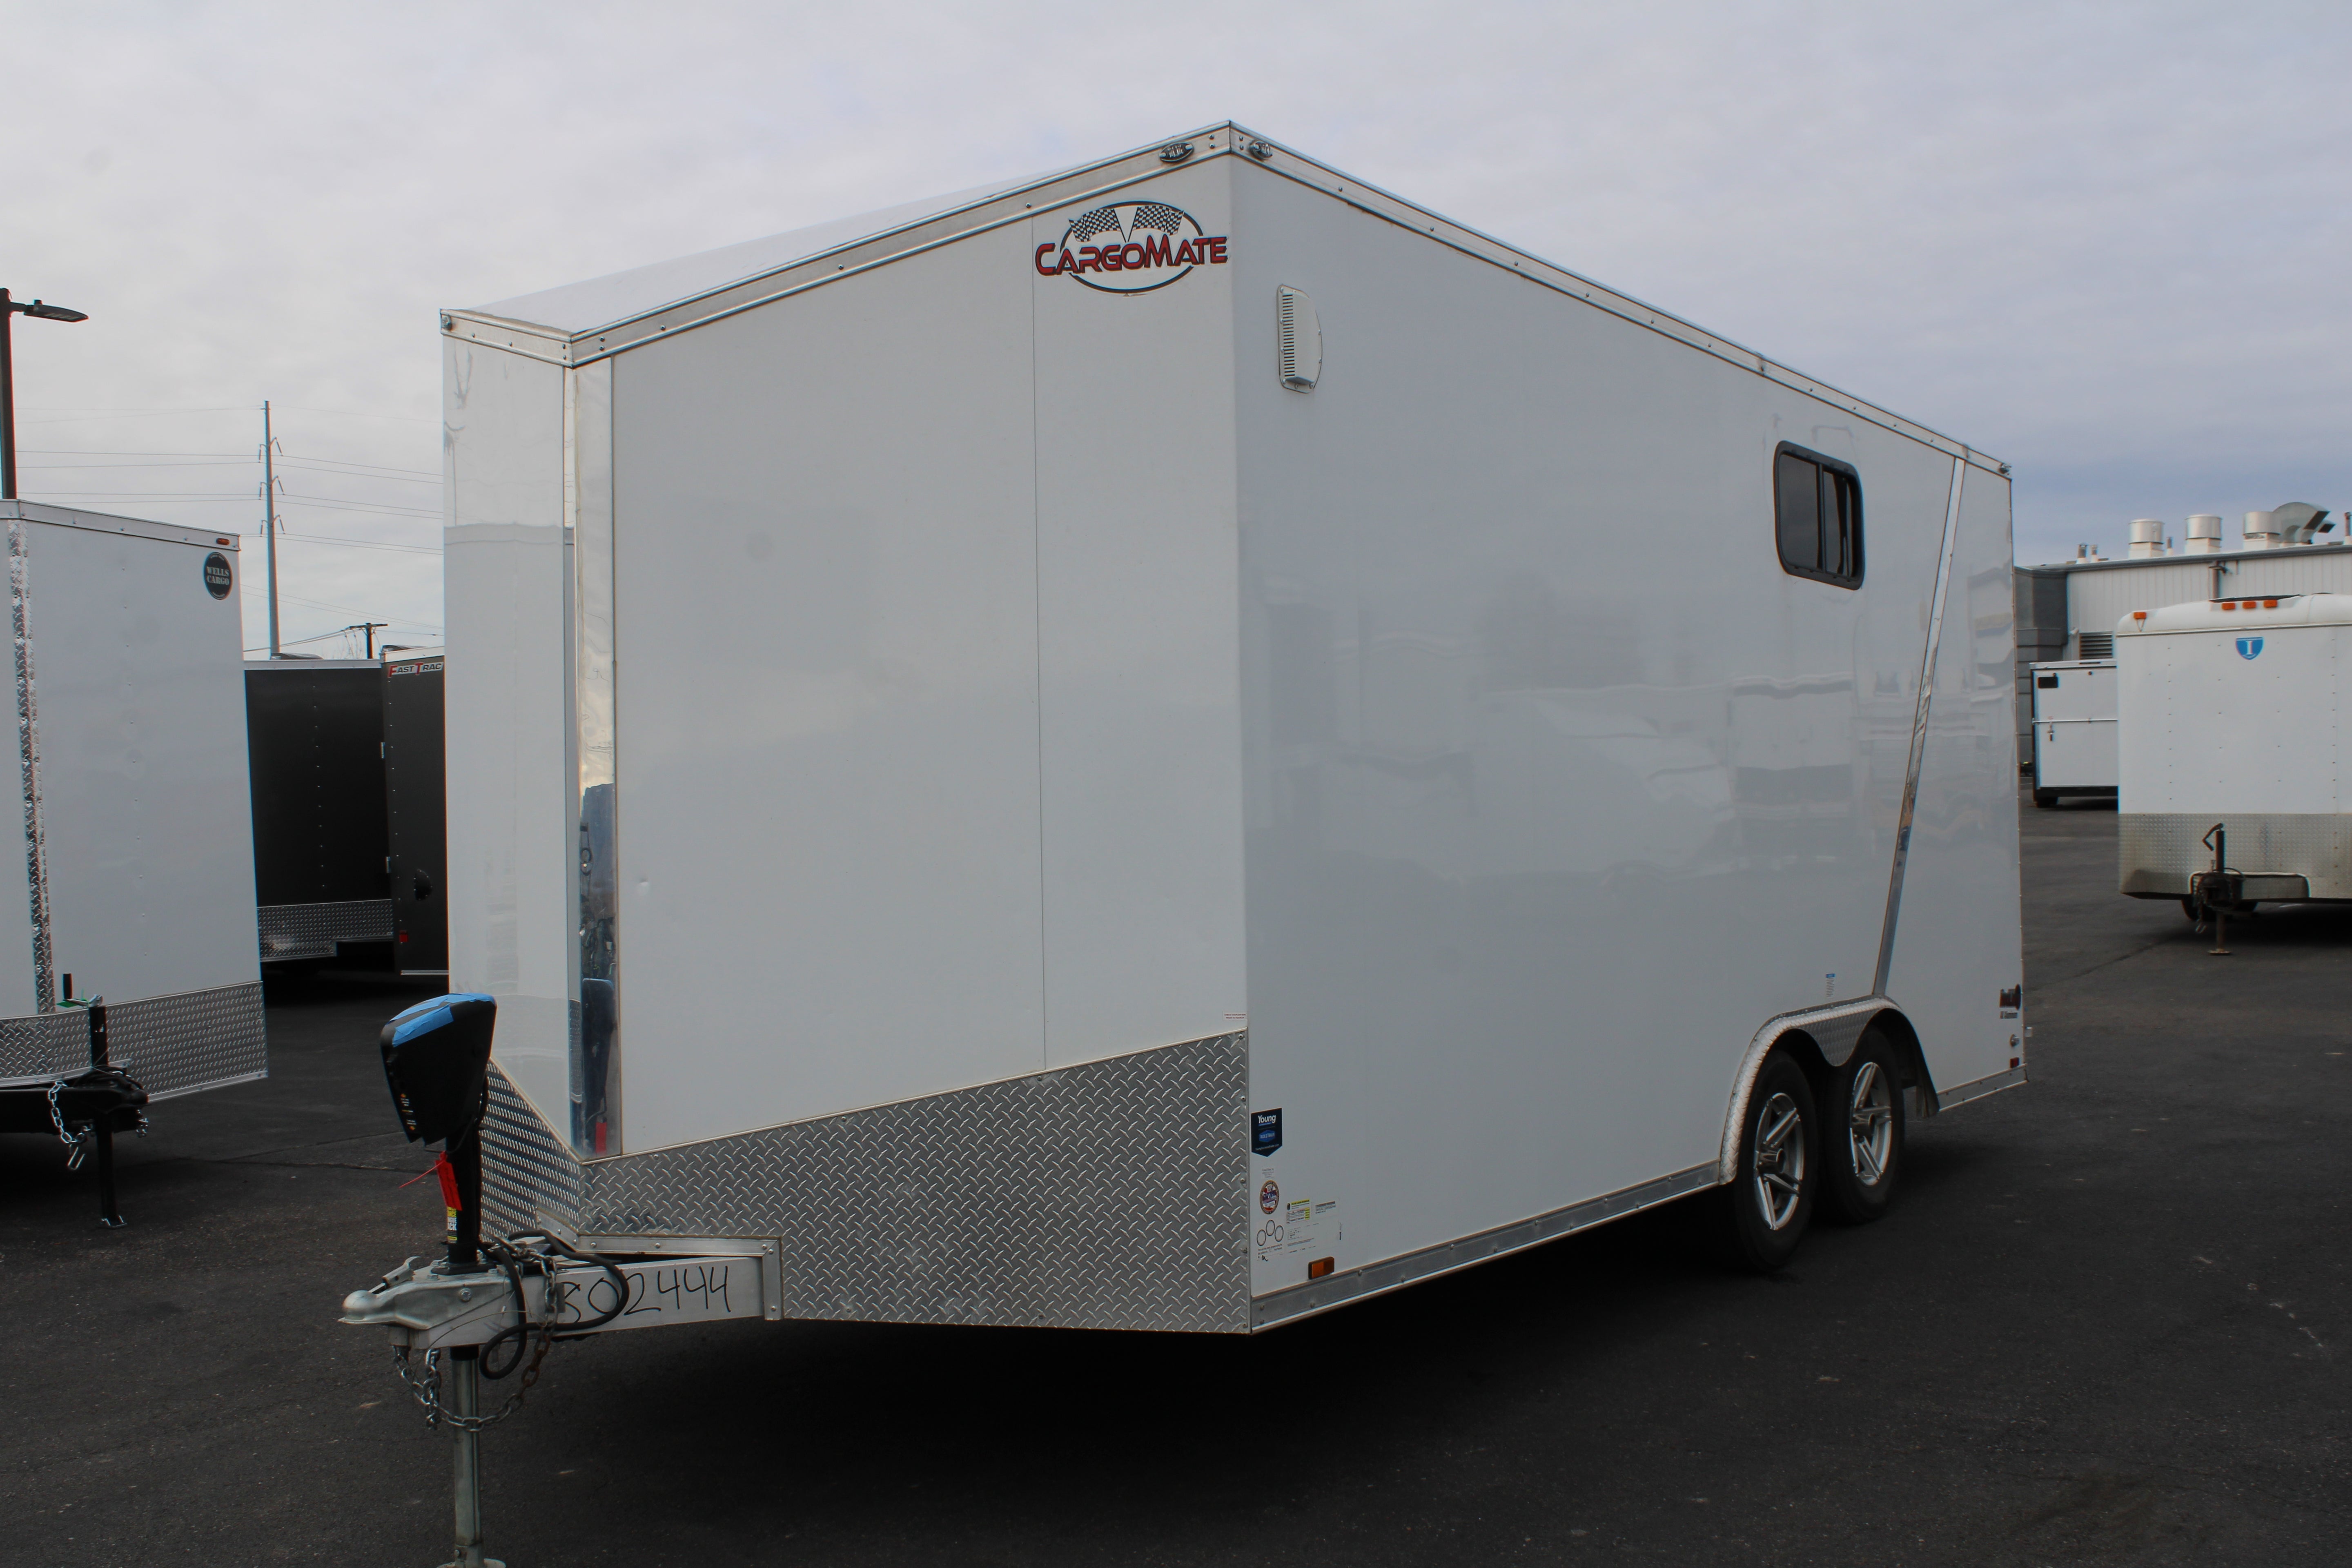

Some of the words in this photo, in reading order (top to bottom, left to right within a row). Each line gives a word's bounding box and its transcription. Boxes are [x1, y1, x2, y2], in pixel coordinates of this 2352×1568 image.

[207, 566, 229, 577] WELLS
[207, 575, 229, 585] CARGO
[1258, 1115, 1276, 1124] Young
